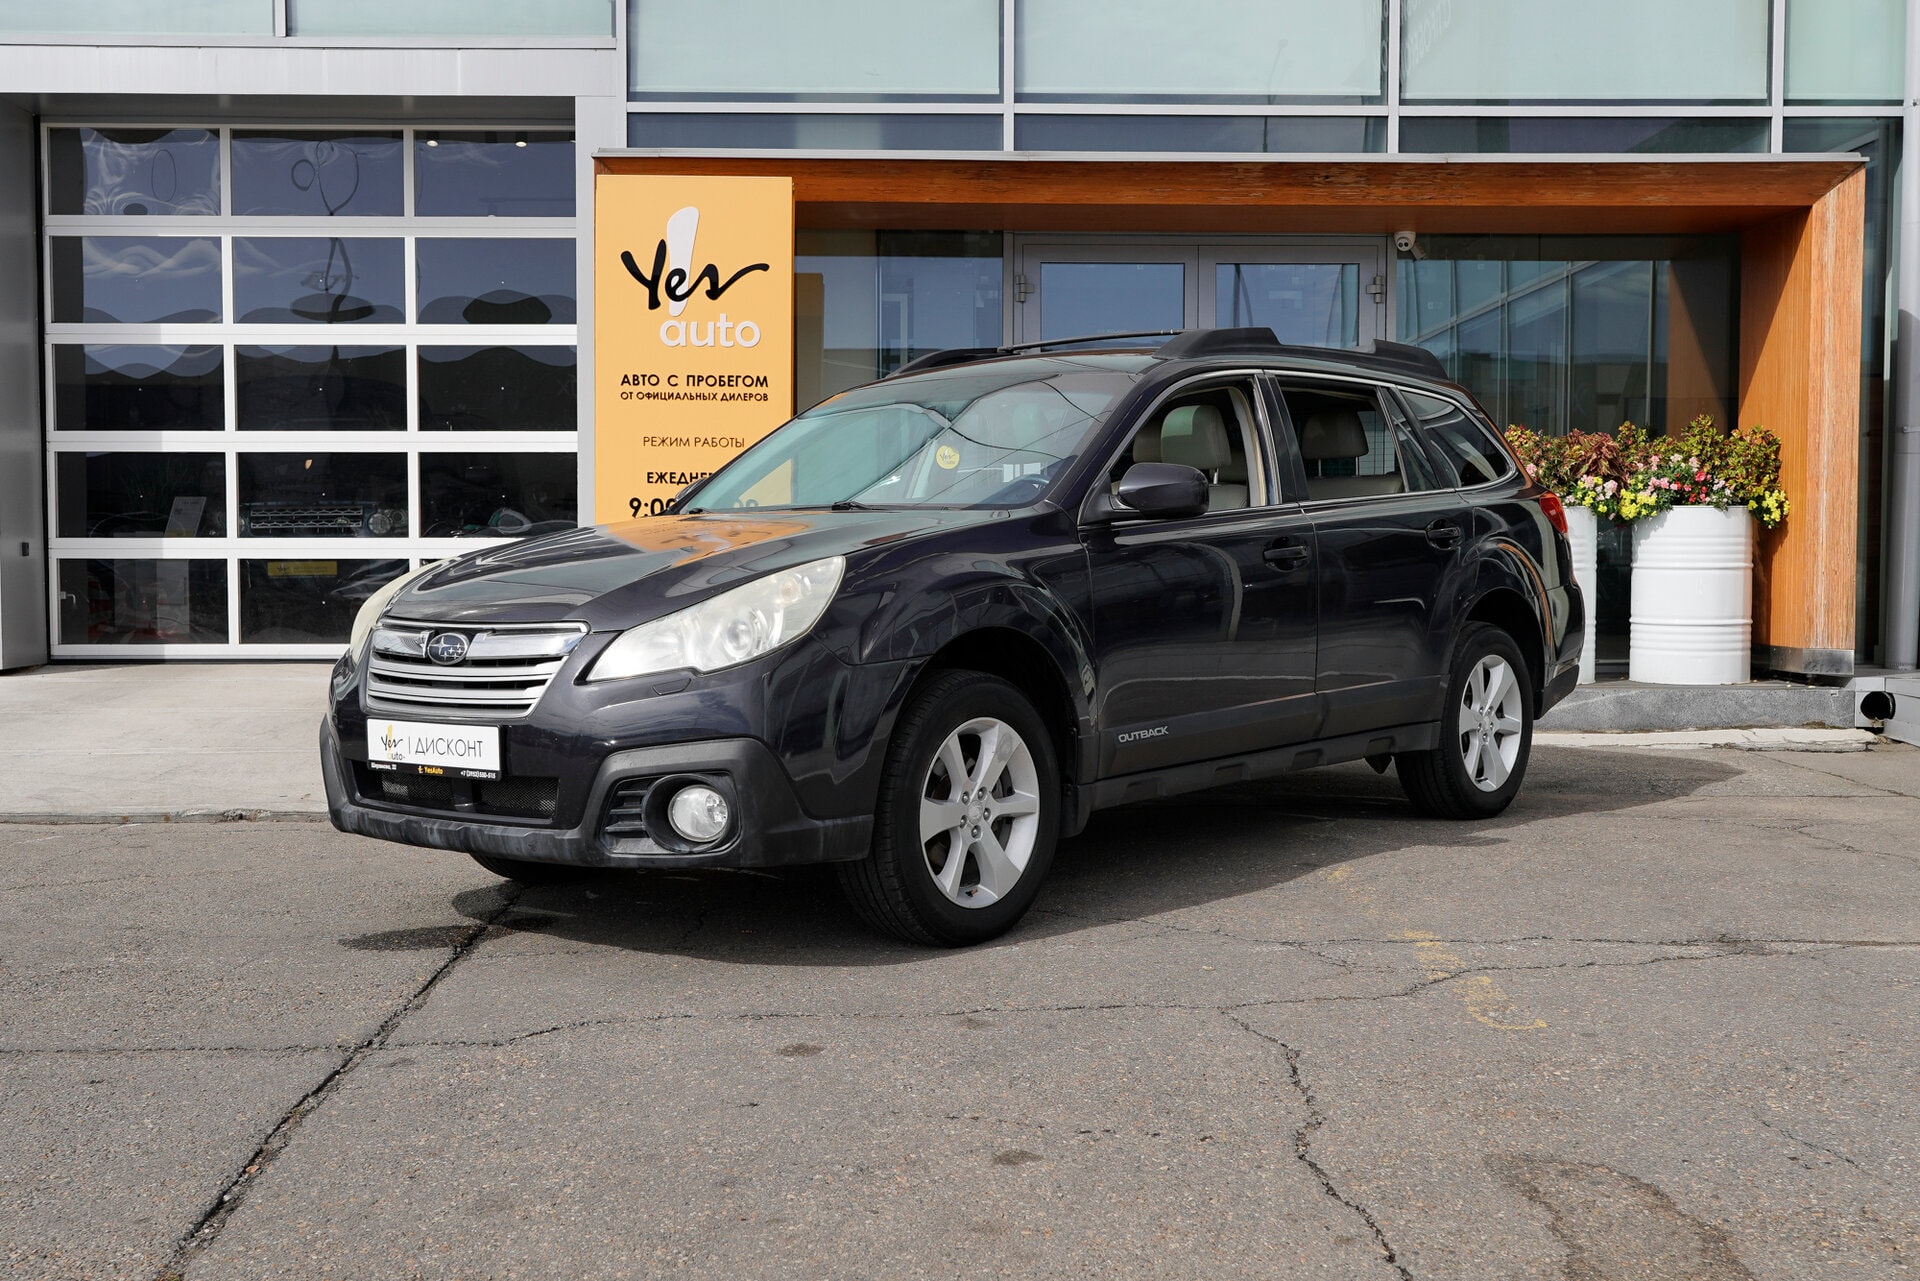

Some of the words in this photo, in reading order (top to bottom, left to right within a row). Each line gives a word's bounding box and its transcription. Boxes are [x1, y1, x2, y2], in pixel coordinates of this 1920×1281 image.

[620, 238, 770, 310] Yes
[659, 313, 761, 348] auto
[620, 374, 660, 387] АВТО
[667, 374, 679, 387] С
[686, 375, 769, 388] ПРОБЕГОМ
[620, 391, 633, 401] ОТ
[636, 391, 718, 402] ОФИЦИАЛЬНЫХ
[720, 392, 769, 402] ДИЛЕРОВ
[643, 436, 690, 447] РЕЖИМ
[694, 437, 745, 448] РАБОТЫ
[1118, 725, 1169, 743] OUTBACK
[415, 736, 483, 758] ДИСКОНТ
